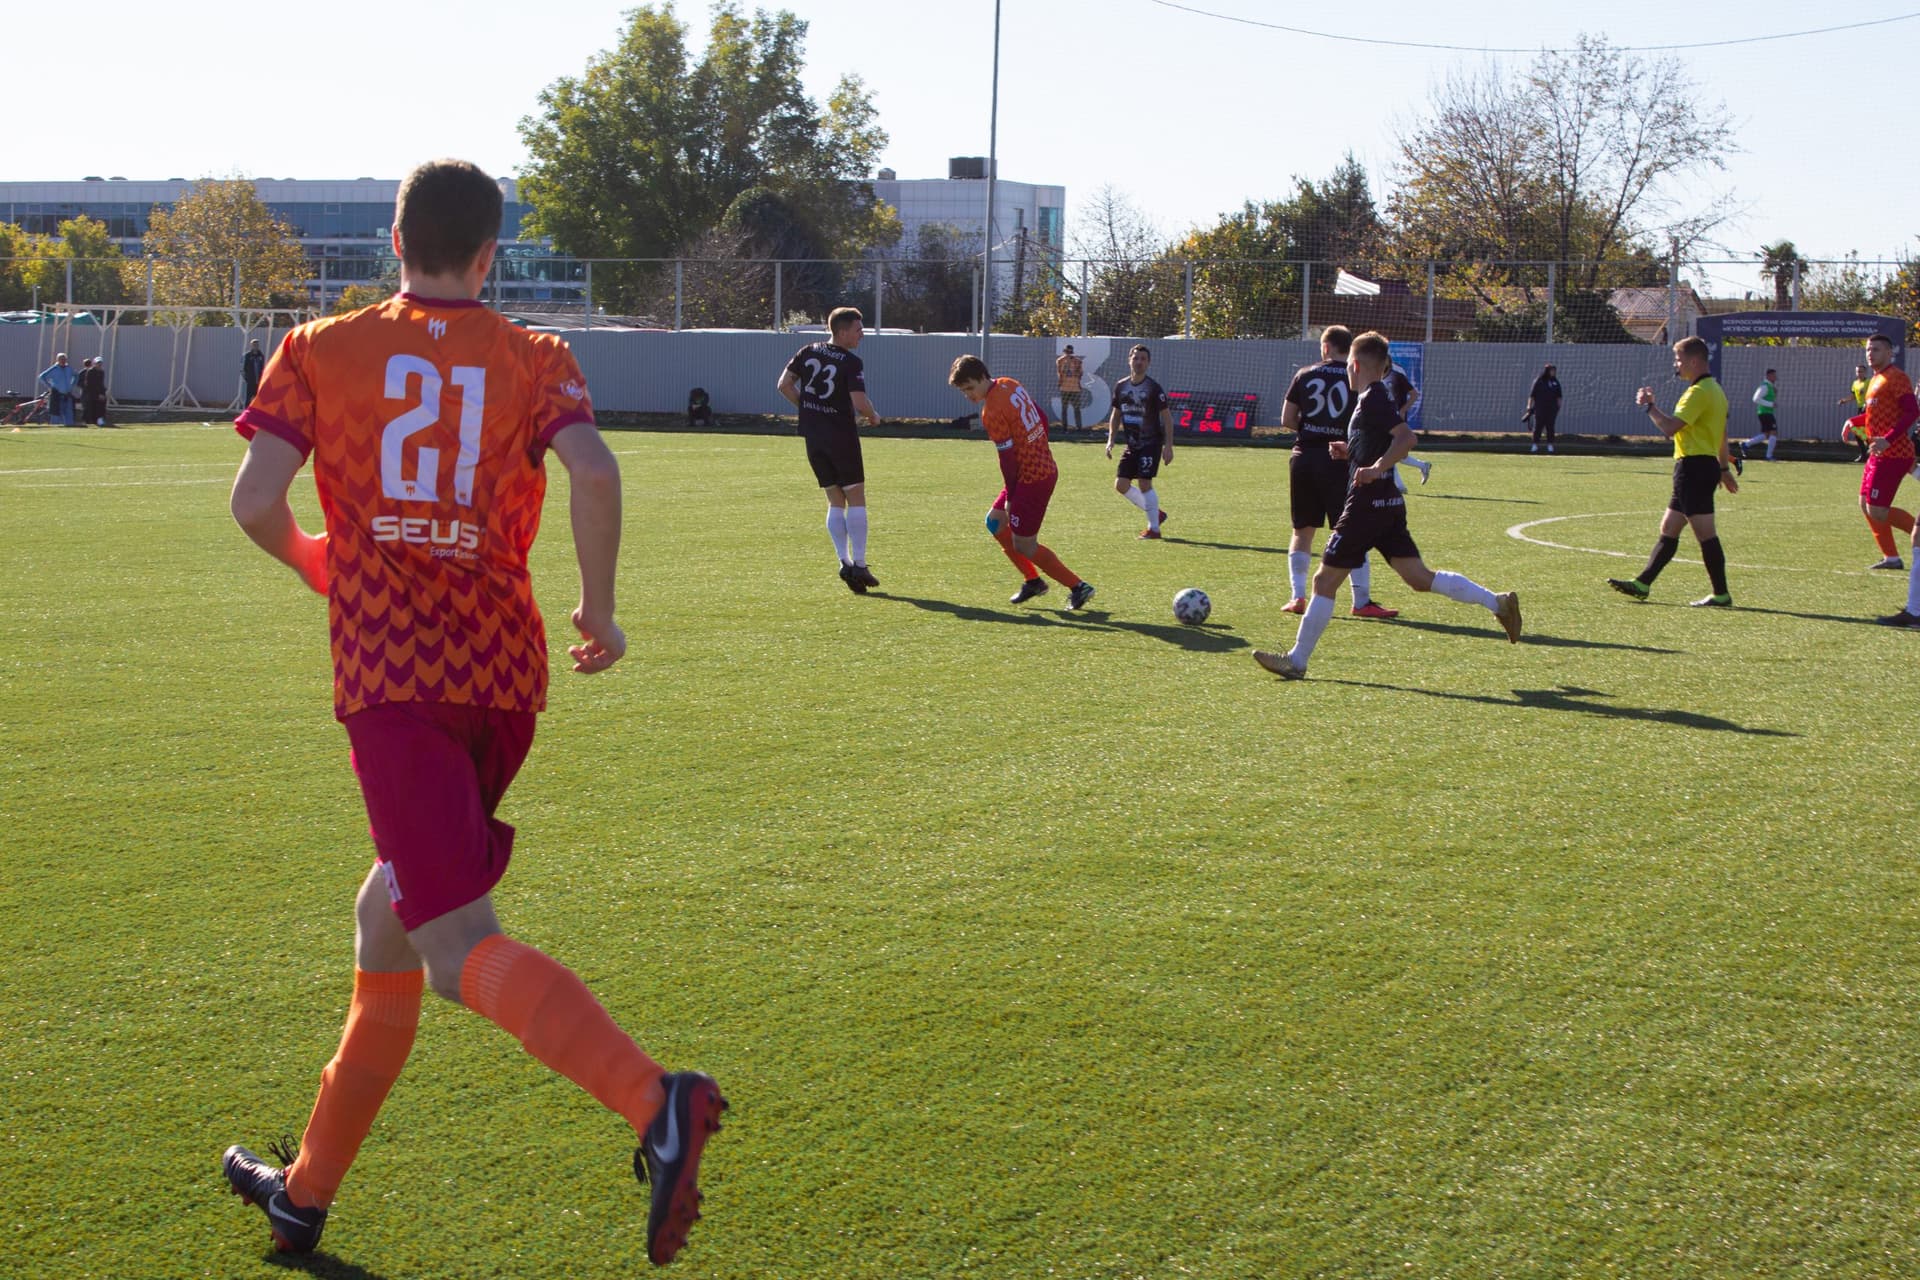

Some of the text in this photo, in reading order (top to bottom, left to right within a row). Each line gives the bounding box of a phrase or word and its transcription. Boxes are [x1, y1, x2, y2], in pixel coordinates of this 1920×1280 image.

[804, 357, 837, 400] 23
[1306, 377, 1349, 419] 30
[381, 353, 487, 507] 21
[1179, 409, 1193, 427] 2
[1234, 411, 1248, 430] 0
[371, 515, 479, 550] SEUS
[430, 546, 459, 559] Export
